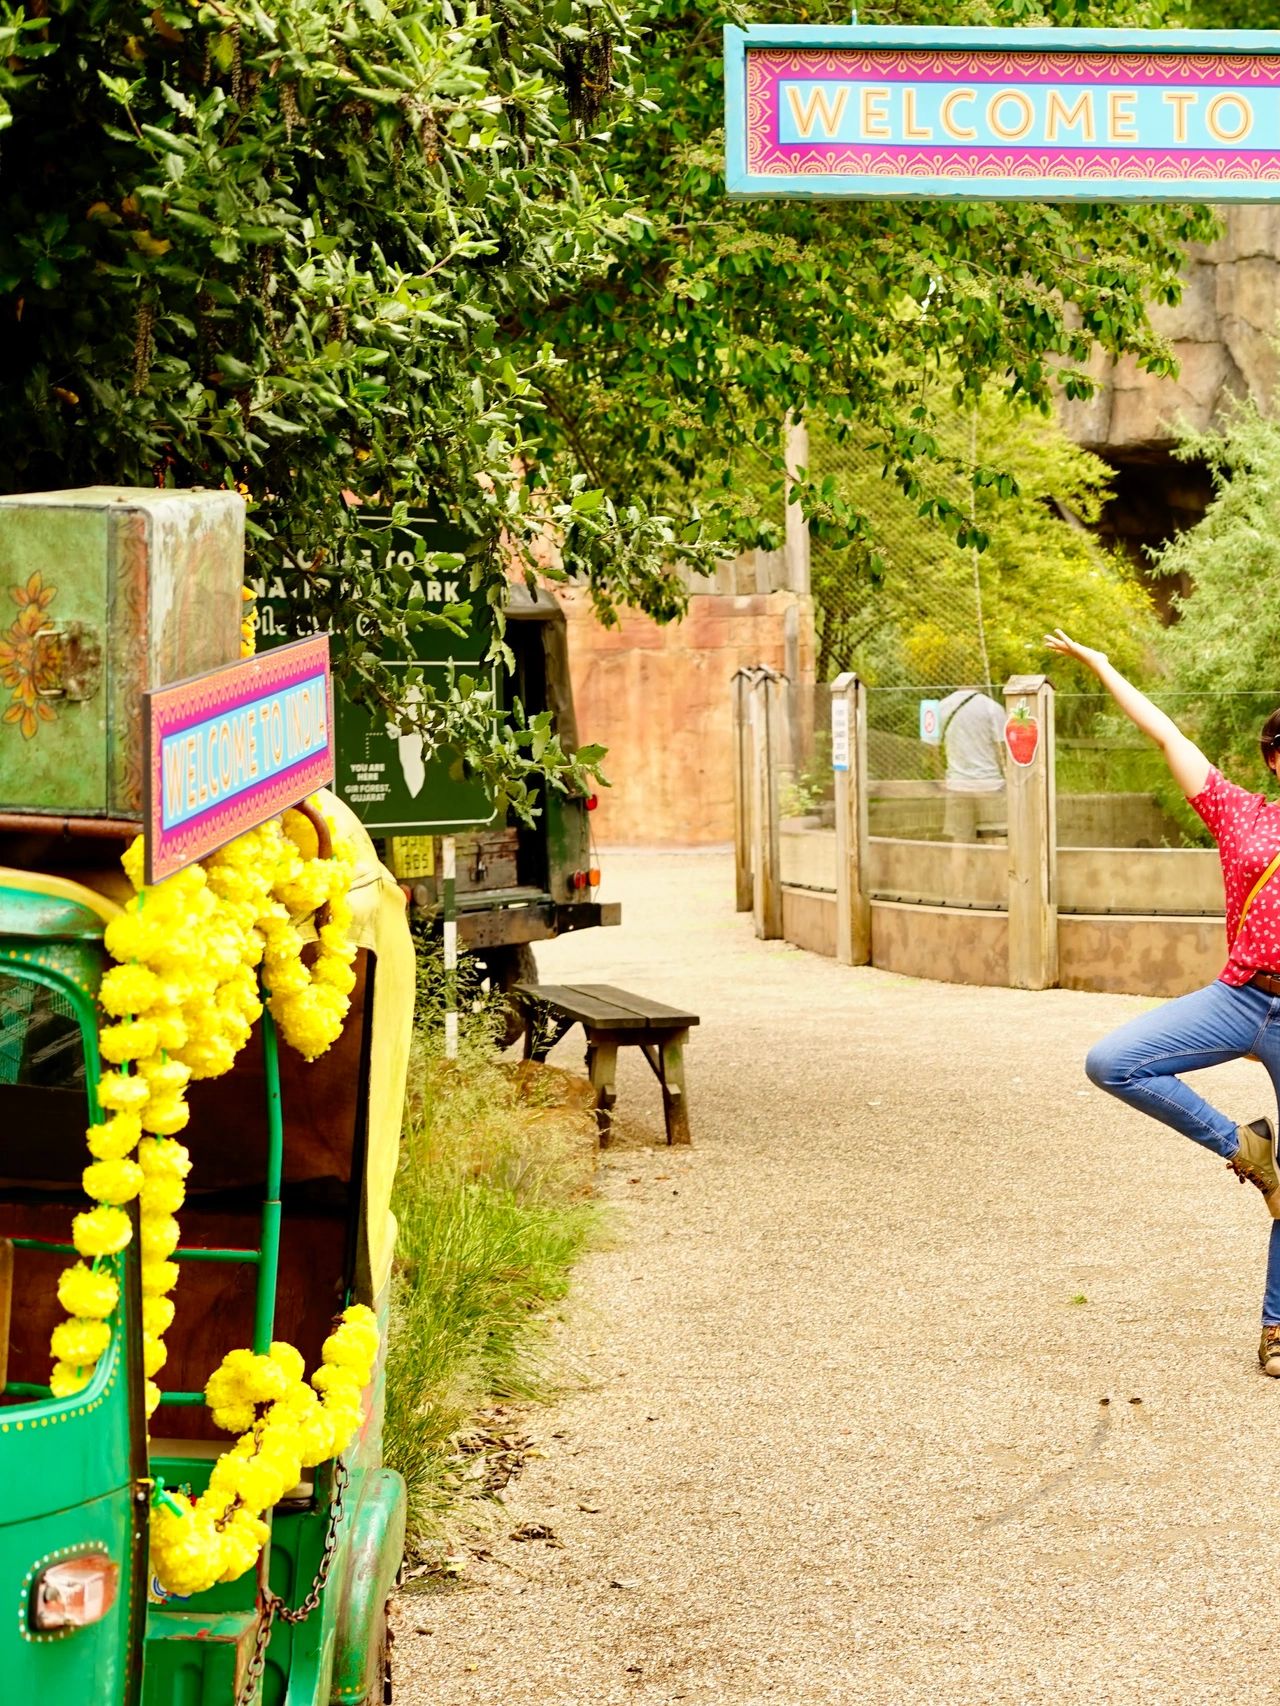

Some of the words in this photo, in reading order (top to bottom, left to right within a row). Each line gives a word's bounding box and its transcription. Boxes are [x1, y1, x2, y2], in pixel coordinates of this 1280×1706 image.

[785, 84, 1140, 142] WELCOME
[1163, 90, 1255, 143] TO
[405, 580, 460, 602] ARK
[163, 708, 259, 820] WELCOME
[259, 700, 284, 771] TO
[285, 681, 328, 760] INDIA
[350, 763, 368, 773] YOU
[368, 763, 385, 772] ARE
[356, 772, 379, 782] HERE
[344, 785, 359, 794] GIR
[350, 793, 386, 803] GUJARAT
